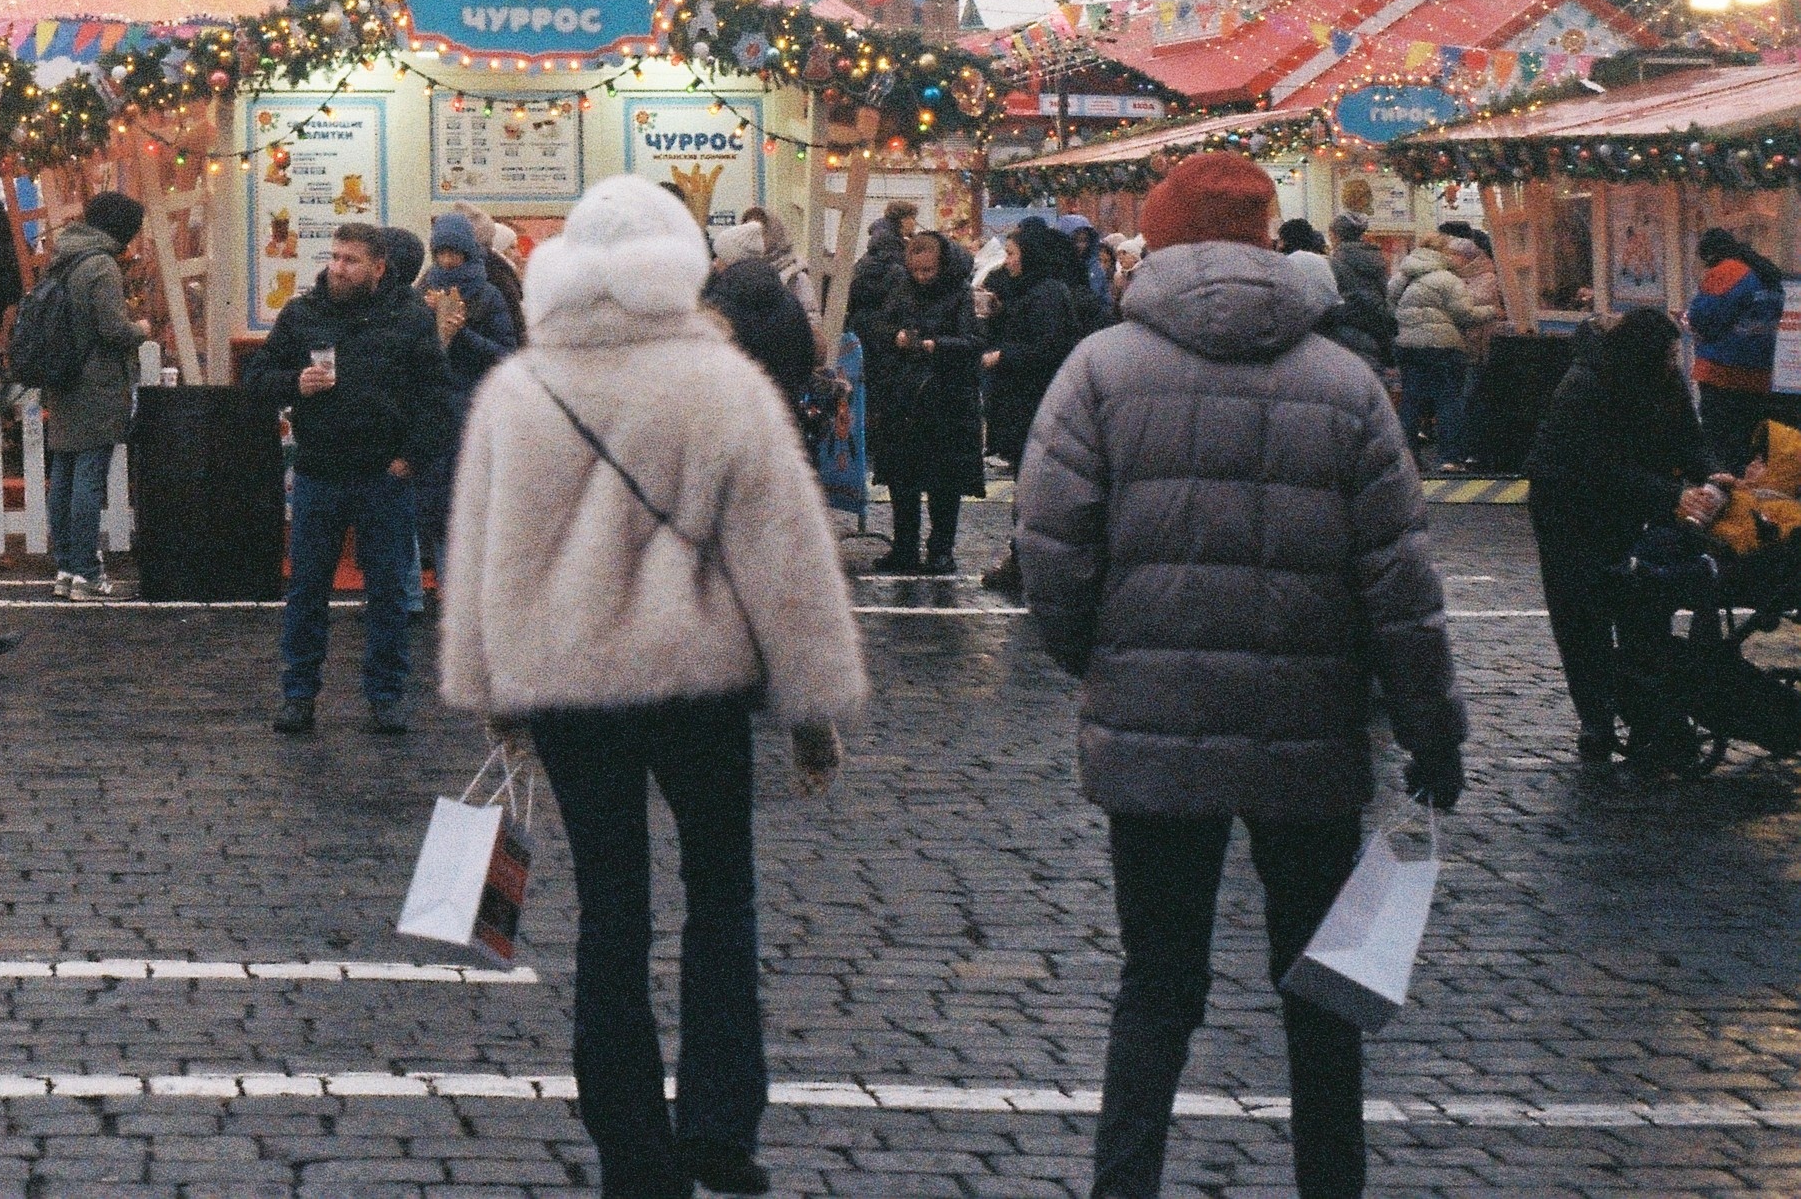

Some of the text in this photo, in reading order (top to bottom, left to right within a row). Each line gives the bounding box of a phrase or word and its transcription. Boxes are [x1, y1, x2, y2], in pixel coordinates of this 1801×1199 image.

[461, 6, 603, 34] ЧУРРОС
[287, 121, 364, 129] СРЕВАЮЩИЕ
[298, 130, 354, 140] АПИТКИ
[645, 132, 744, 151] ЧУРРОС
